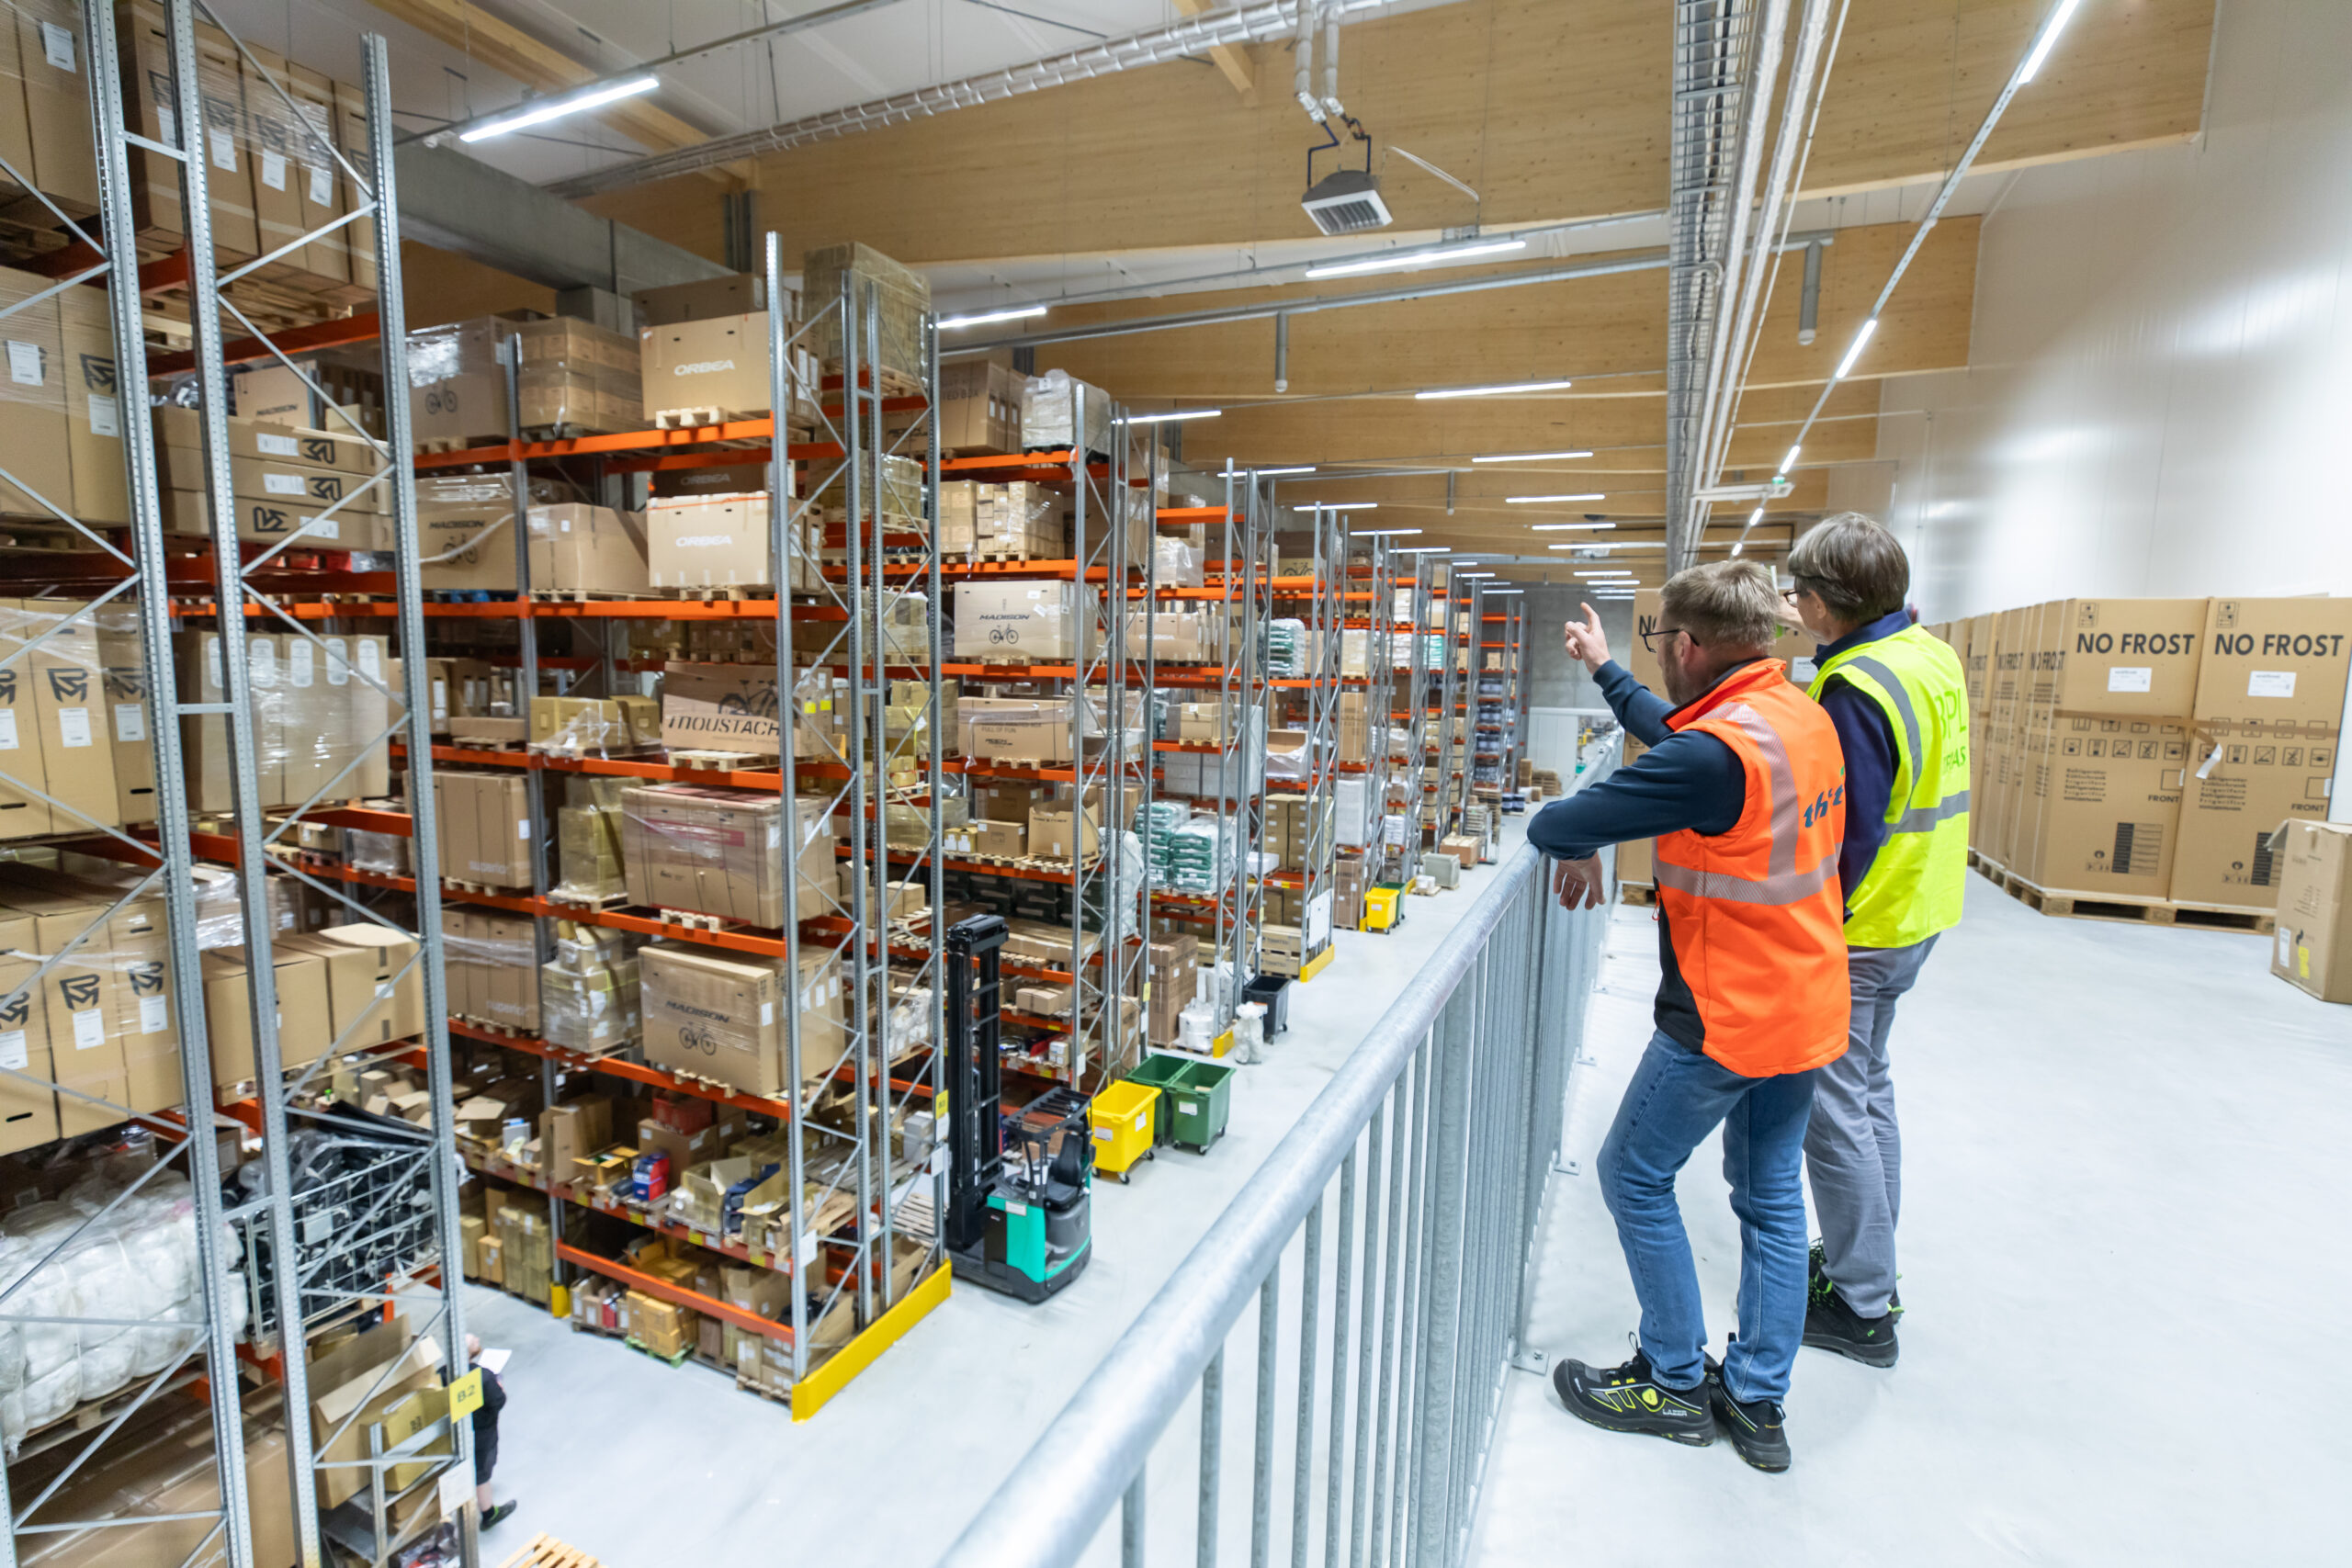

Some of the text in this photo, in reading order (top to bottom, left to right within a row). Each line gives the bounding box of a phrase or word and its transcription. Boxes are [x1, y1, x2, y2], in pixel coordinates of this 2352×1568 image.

[674, 359, 736, 376] ORBEA
[675, 535, 733, 547] ORBEA
[2076, 633, 2196, 655] NO FROST
[2214, 634, 2345, 657] NO FROST
[669, 716, 781, 737] MOUSTACH
[2148, 794, 2179, 803] FRONT
[2291, 803, 2324, 813] FRONT
[665, 999, 730, 1023] MADISON
